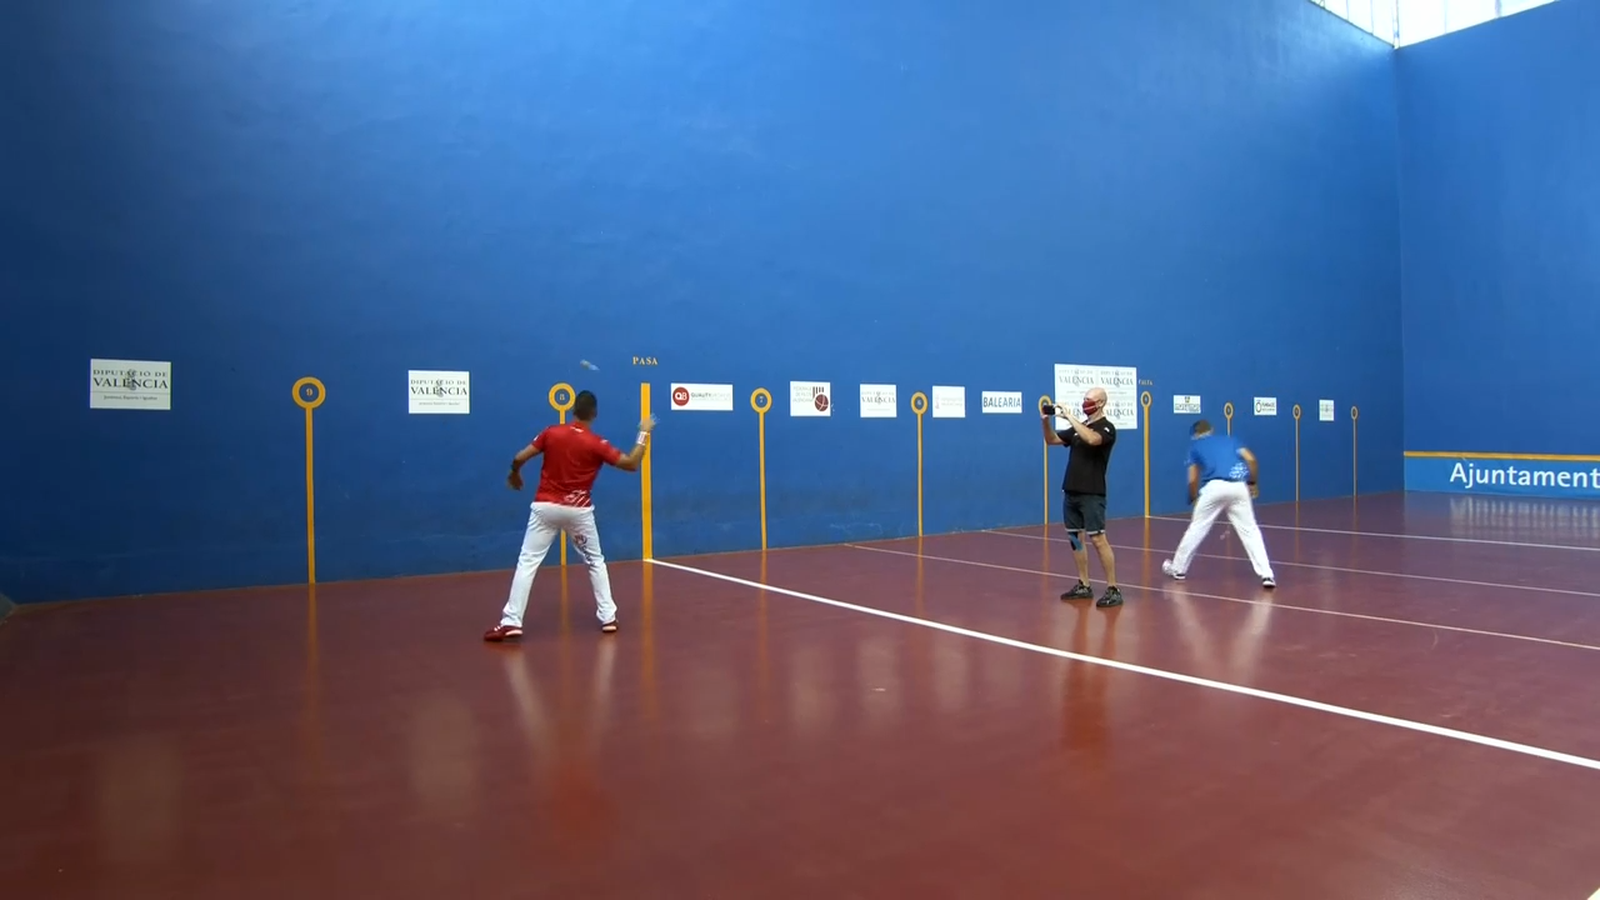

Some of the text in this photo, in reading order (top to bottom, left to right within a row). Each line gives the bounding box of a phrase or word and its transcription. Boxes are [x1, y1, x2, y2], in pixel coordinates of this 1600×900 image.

[632, 356, 658, 365] PASA
[306, 388, 313, 396] 9
[1449, 462, 1600, 489] Ajuntament
